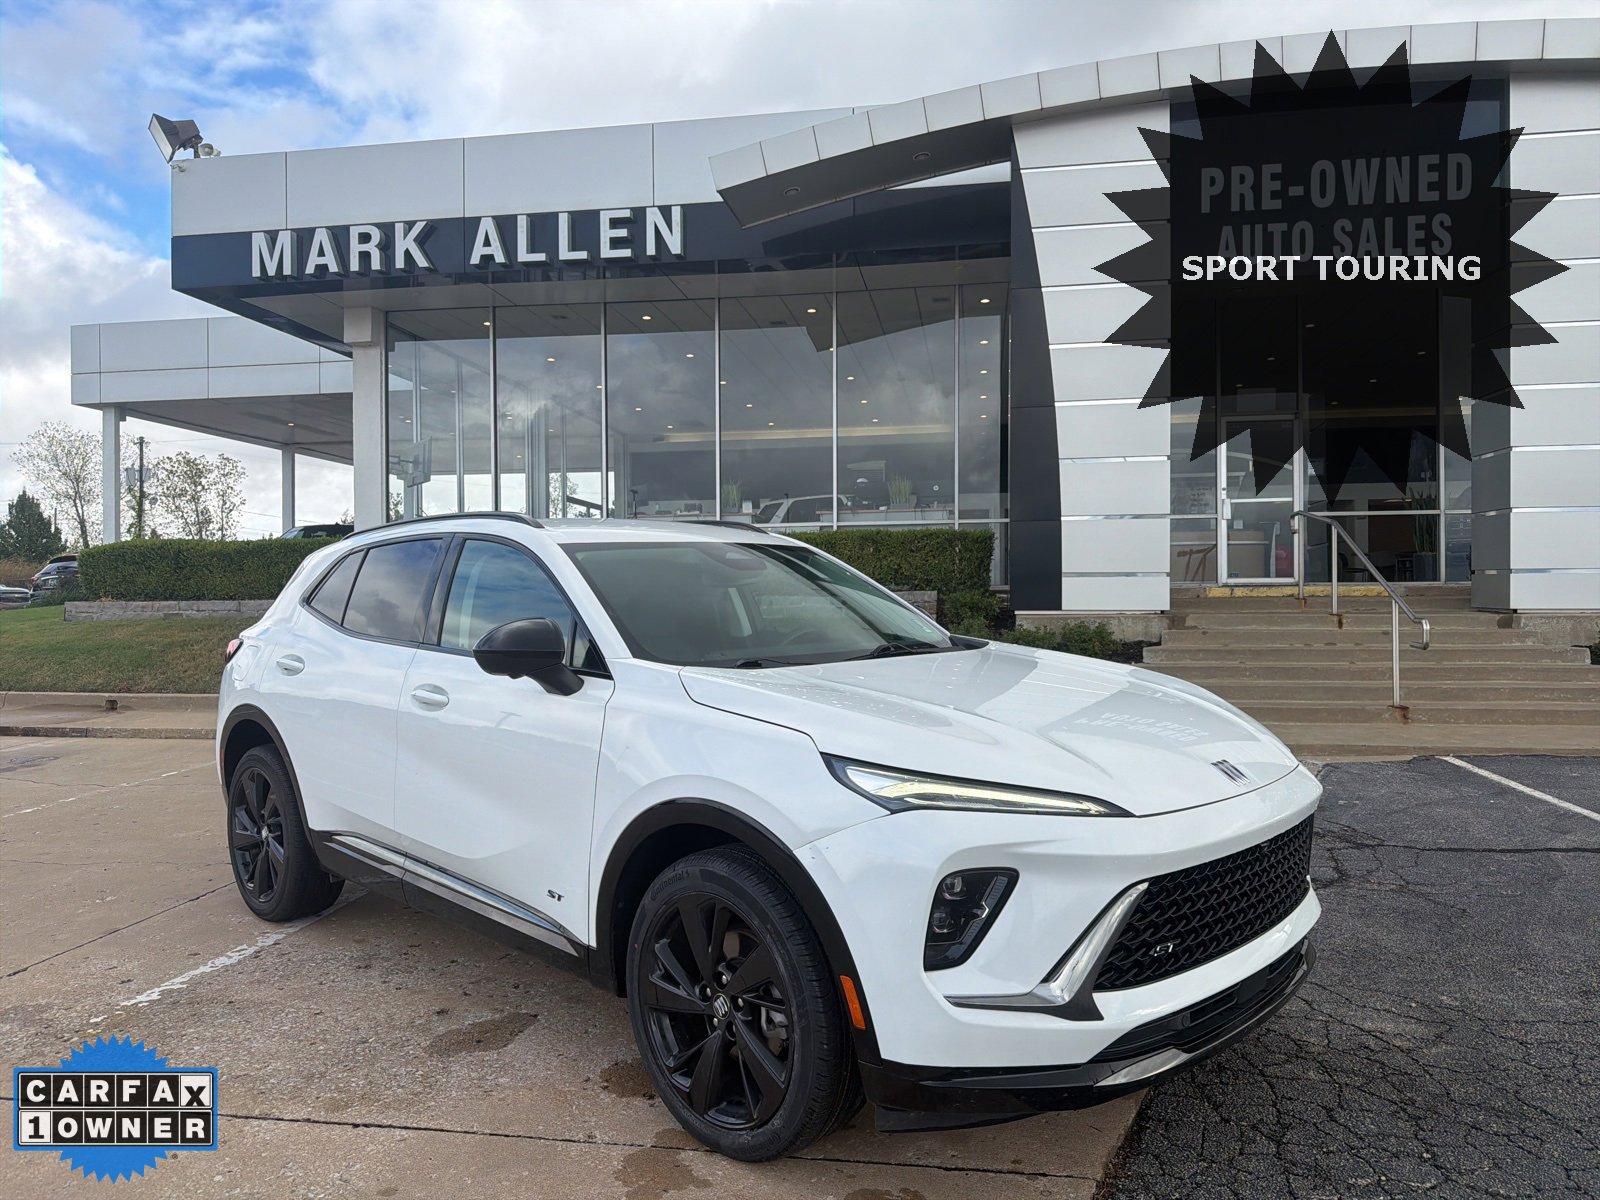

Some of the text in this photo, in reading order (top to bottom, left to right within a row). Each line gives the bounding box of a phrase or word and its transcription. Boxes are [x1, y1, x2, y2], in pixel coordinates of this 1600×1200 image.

[1200, 152, 1473, 214] PRE-OWNED
[251, 205, 686, 279] MARK ALLEN
[1217, 212, 1454, 265] AUTO SALES
[546, 889, 565, 902] ST
